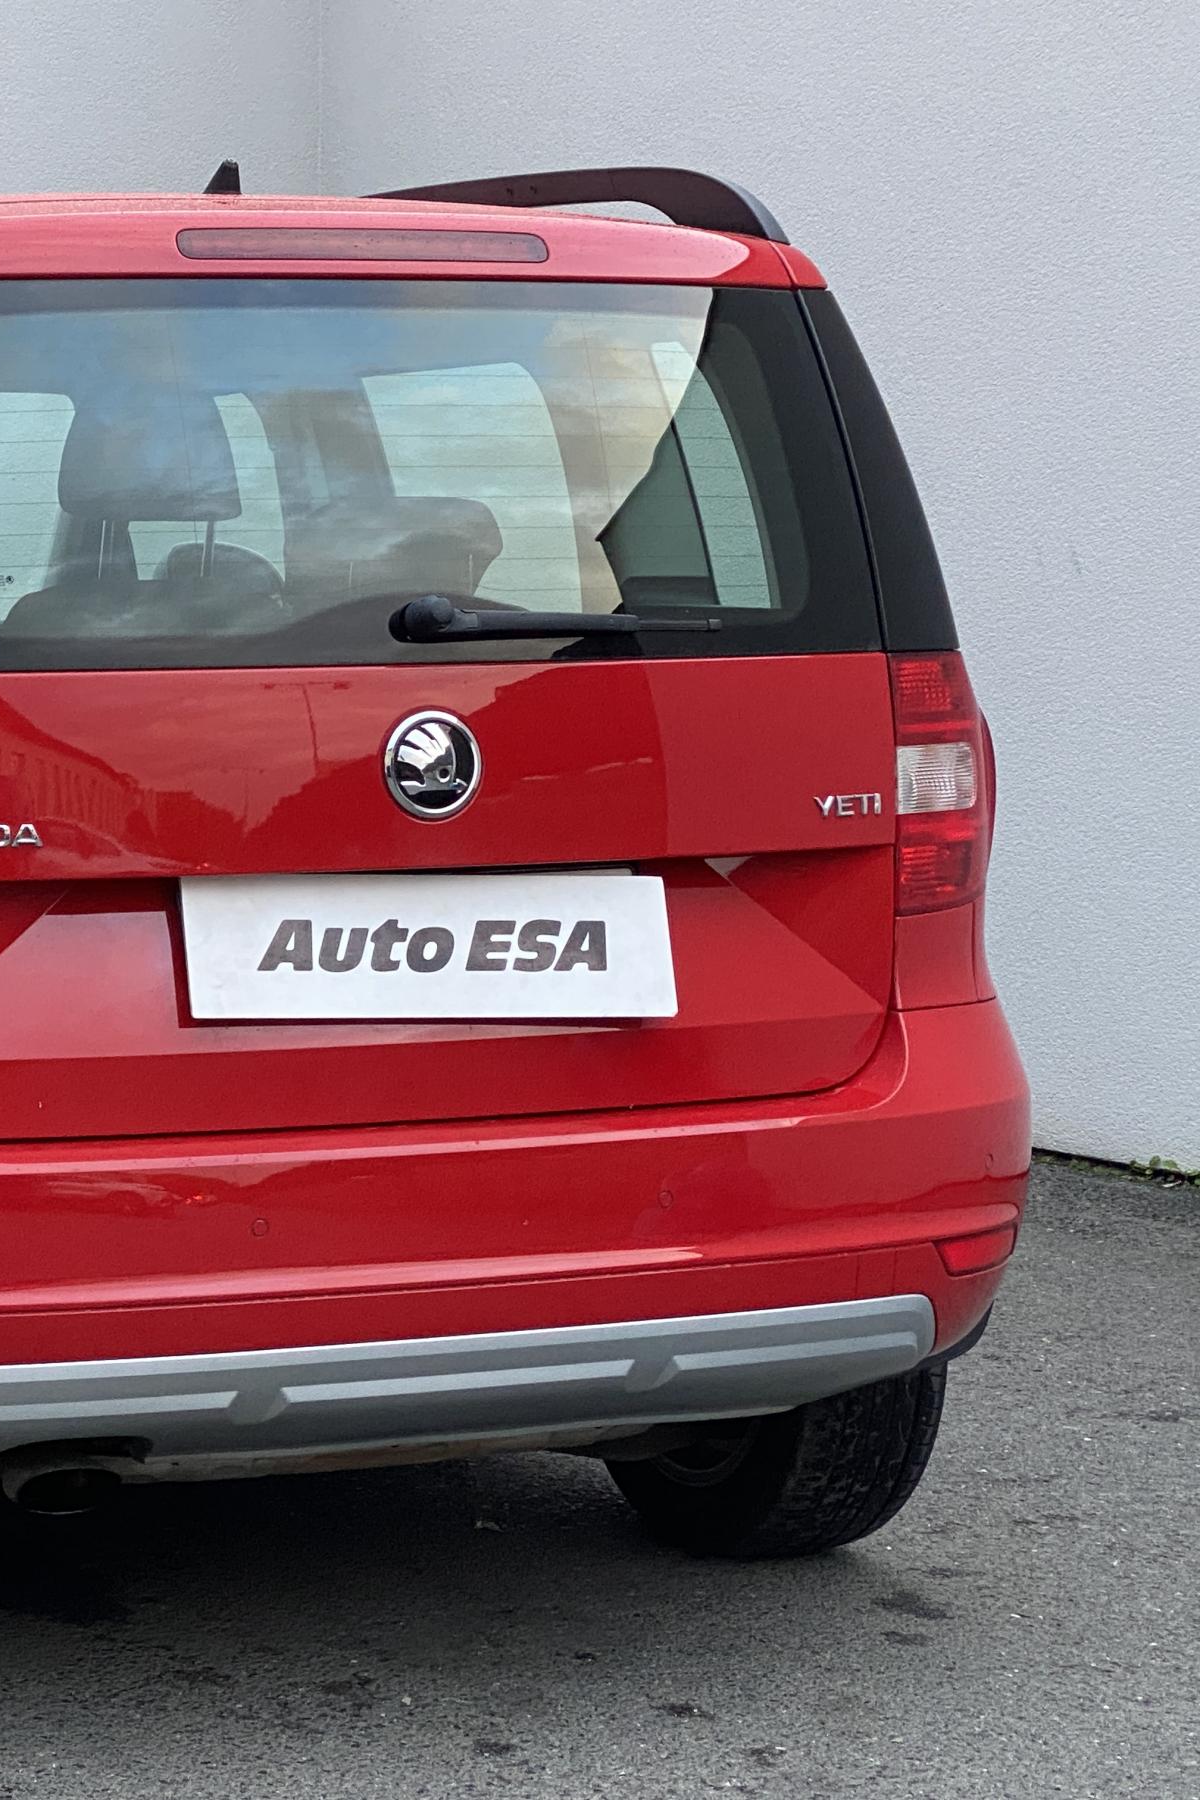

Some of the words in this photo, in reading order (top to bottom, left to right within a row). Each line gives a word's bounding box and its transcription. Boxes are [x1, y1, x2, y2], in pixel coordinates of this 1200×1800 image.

[813, 793, 881, 816] YETI
[257, 918, 455, 973] Auto
[465, 919, 607, 972] ESA
